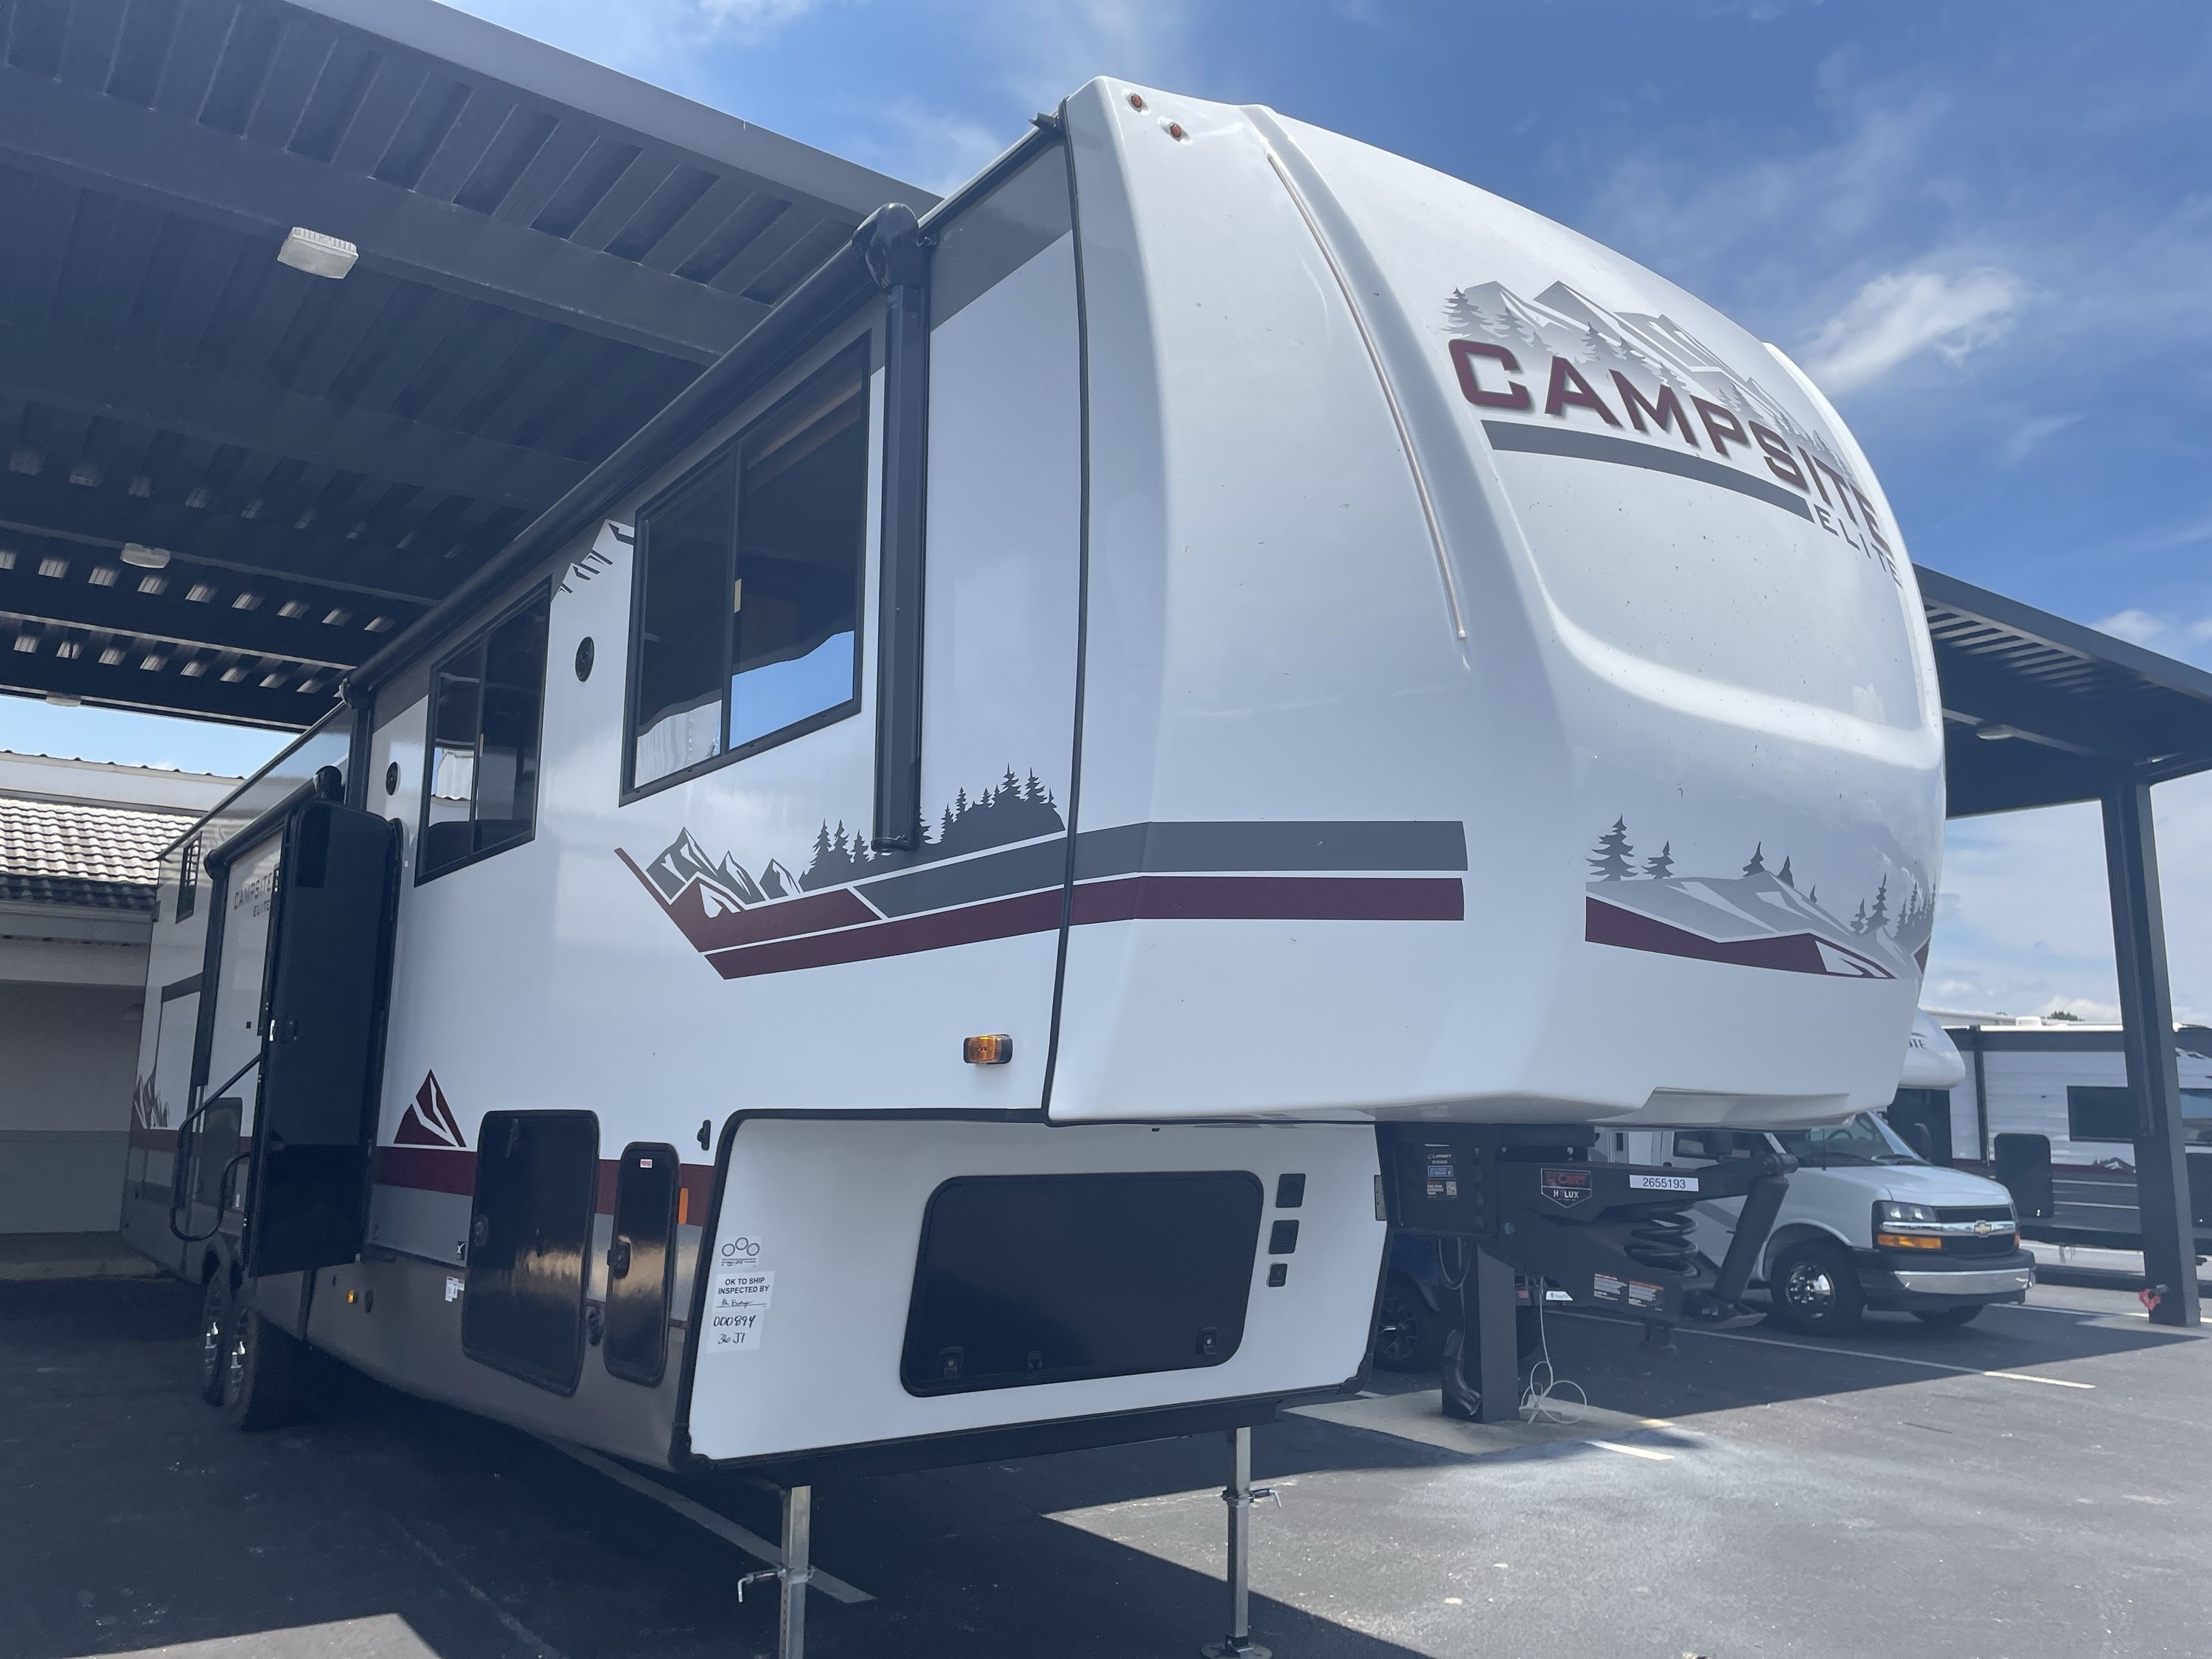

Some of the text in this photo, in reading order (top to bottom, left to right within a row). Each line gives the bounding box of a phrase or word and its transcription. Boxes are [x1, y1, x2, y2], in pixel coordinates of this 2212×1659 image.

[1448, 338, 1895, 562] CAMPSITE
[1813, 503, 1903, 590] ELITE
[234, 872, 273, 910] CAMPSITE
[253, 899, 271, 917] ELITE
[1643, 1177, 1686, 1189] 2655193
[748, 1276, 765, 1284] SHIP
[718, 1286, 758, 1295] INSPECTED
